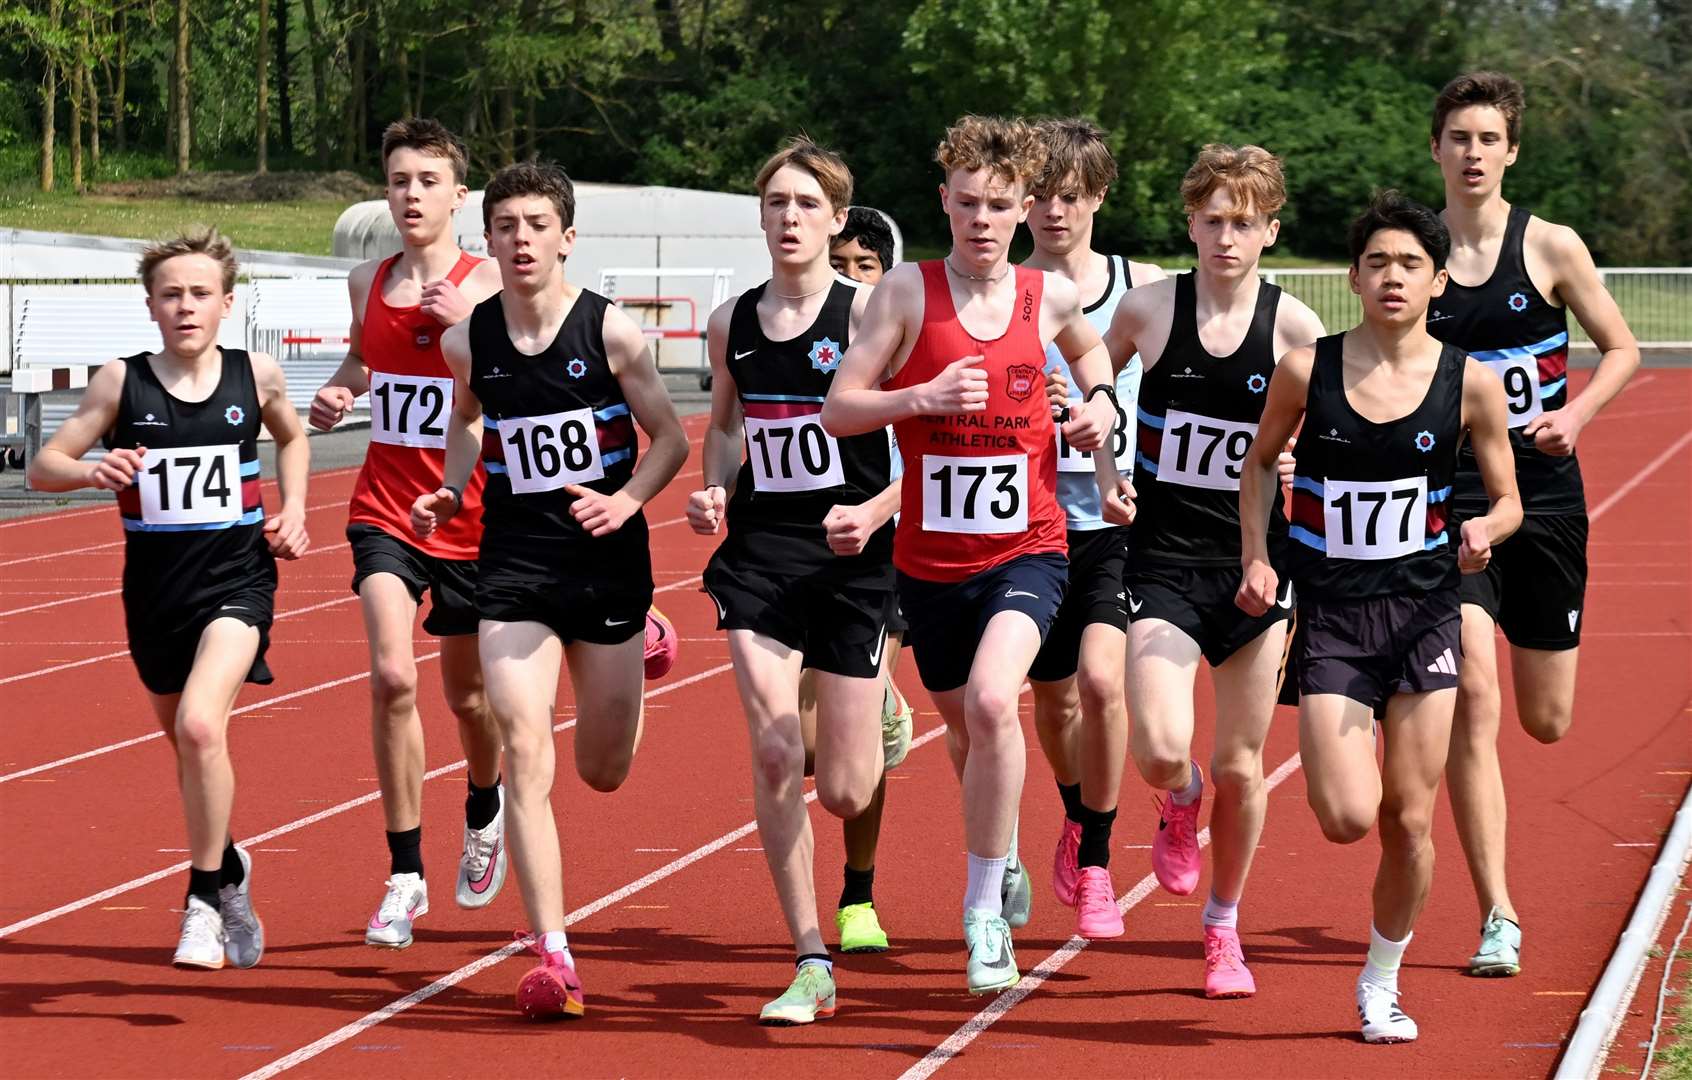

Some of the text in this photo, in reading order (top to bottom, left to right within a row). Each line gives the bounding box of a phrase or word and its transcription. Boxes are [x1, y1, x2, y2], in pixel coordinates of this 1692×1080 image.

[1022, 288, 1033, 323] soar
[375, 382, 444, 436] 172
[994, 416, 1031, 429] PARK
[507, 419, 593, 480] 168
[752, 422, 831, 479] 170
[929, 431, 1017, 448] ATHLETICS
[1170, 421, 1254, 479] 179
[147, 455, 231, 511] 174
[929, 463, 1020, 520] 173
[1330, 487, 1419, 546] 177
